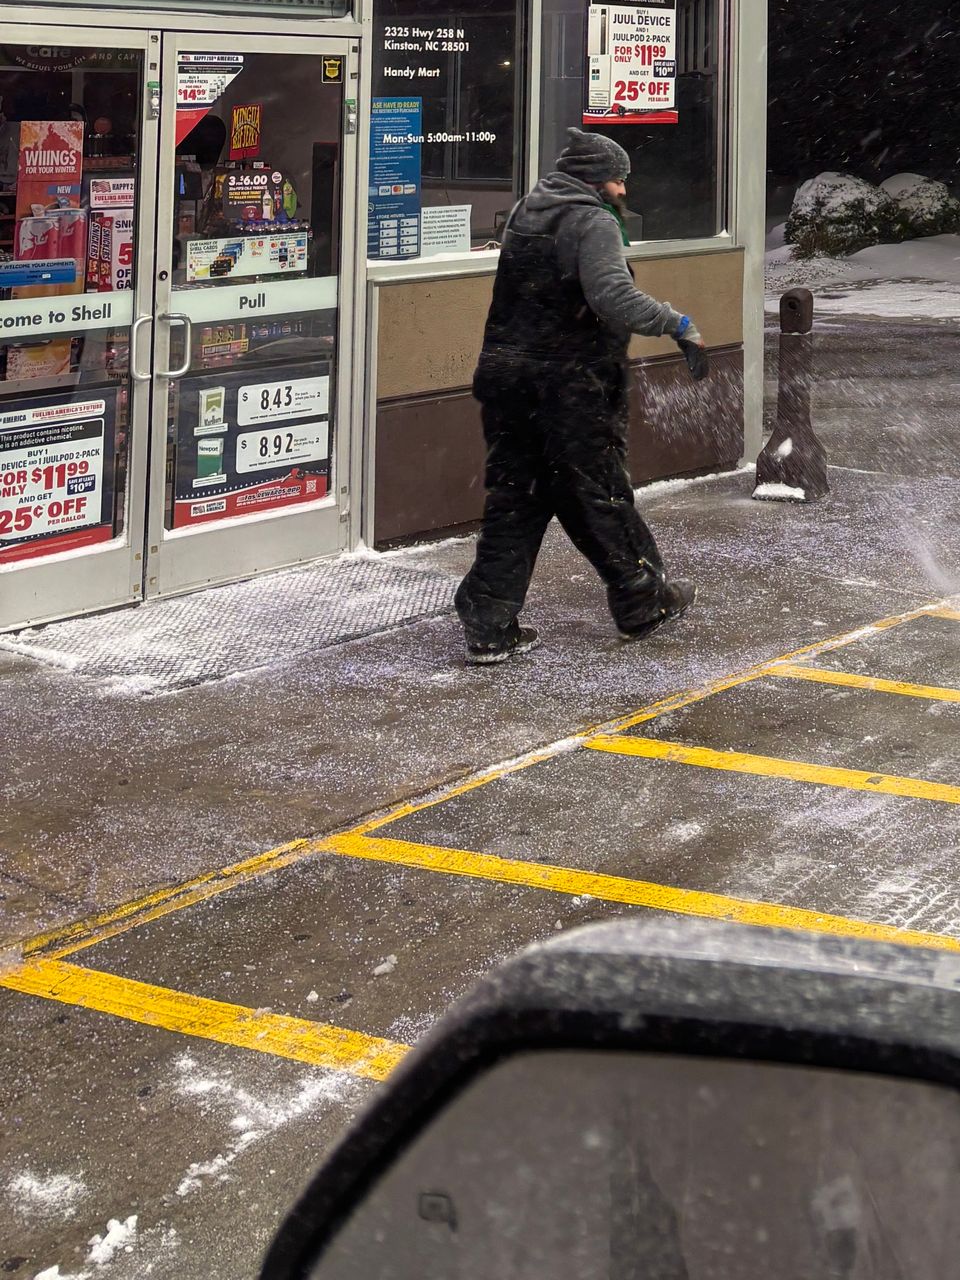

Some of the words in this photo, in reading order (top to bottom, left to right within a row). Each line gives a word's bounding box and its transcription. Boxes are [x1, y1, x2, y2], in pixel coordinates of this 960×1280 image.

[613, 14, 636, 25] JUUL
[637, 15, 671, 26] DEVICE
[384, 27, 409, 37] 2325
[412, 28, 434, 40] Hwy
[436, 29, 454, 38] 258
[456, 29, 465, 38] N
[612, 33, 644, 42] JUULPOD
[646, 34, 671, 43] 2-PACK
[384, 40, 422, 52] Kinston,
[425, 41, 439, 51] NC
[441, 42, 470, 51] 28501
[614, 46, 632, 55] FOR
[384, 66, 415, 79] Handy
[418, 67, 440, 77] Mart
[614, 80, 646, 101] 25¢
[648, 82, 670, 96] OFF
[383, 133, 424, 143] Mon-Sun
[427, 131, 496, 144] 5:00am-11:00p
[25, 166, 37, 174] FOR
[38, 166, 54, 174] YOUR
[112, 183, 129, 191] HAPPY
[228, 176, 236, 186] 3
[240, 175, 267, 185] $6.00
[57, 186, 71, 194] NEW
[91, 222, 100, 259] SNICKERS
[102, 228, 111, 261] SNICKERS
[239, 293, 266, 310] Pull
[0, 314, 42, 329] ome
[49, 311, 65, 324] to
[71, 303, 112, 322] Shell
[242, 392, 248, 402] $
[260, 386, 292, 411] 8.43
[3, 414, 27, 424] AMERICA
[55, 406, 82, 416] AMERICA'S
[83, 403, 103, 411] FUTURE
[13, 431, 35, 441] product
[36, 428, 60, 436] contains
[61, 425, 84, 433] nicotine.
[20, 437, 45, 446] addictive
[46, 433, 72, 441] chemical.
[241, 440, 247, 449] $
[259, 433, 293, 458] 8.92
[2, 459, 27, 471] DEVICE
[42, 452, 74, 465] JUULPOD
[76, 448, 100, 460] 2-PACK
[18, 496, 35, 504] AND
[37, 492, 52, 501] GET
[0, 505, 44, 535] 25¢
[47, 497, 87, 518] OFF
[47, 518, 61, 526] PER
[61, 513, 86, 524] GALLON
